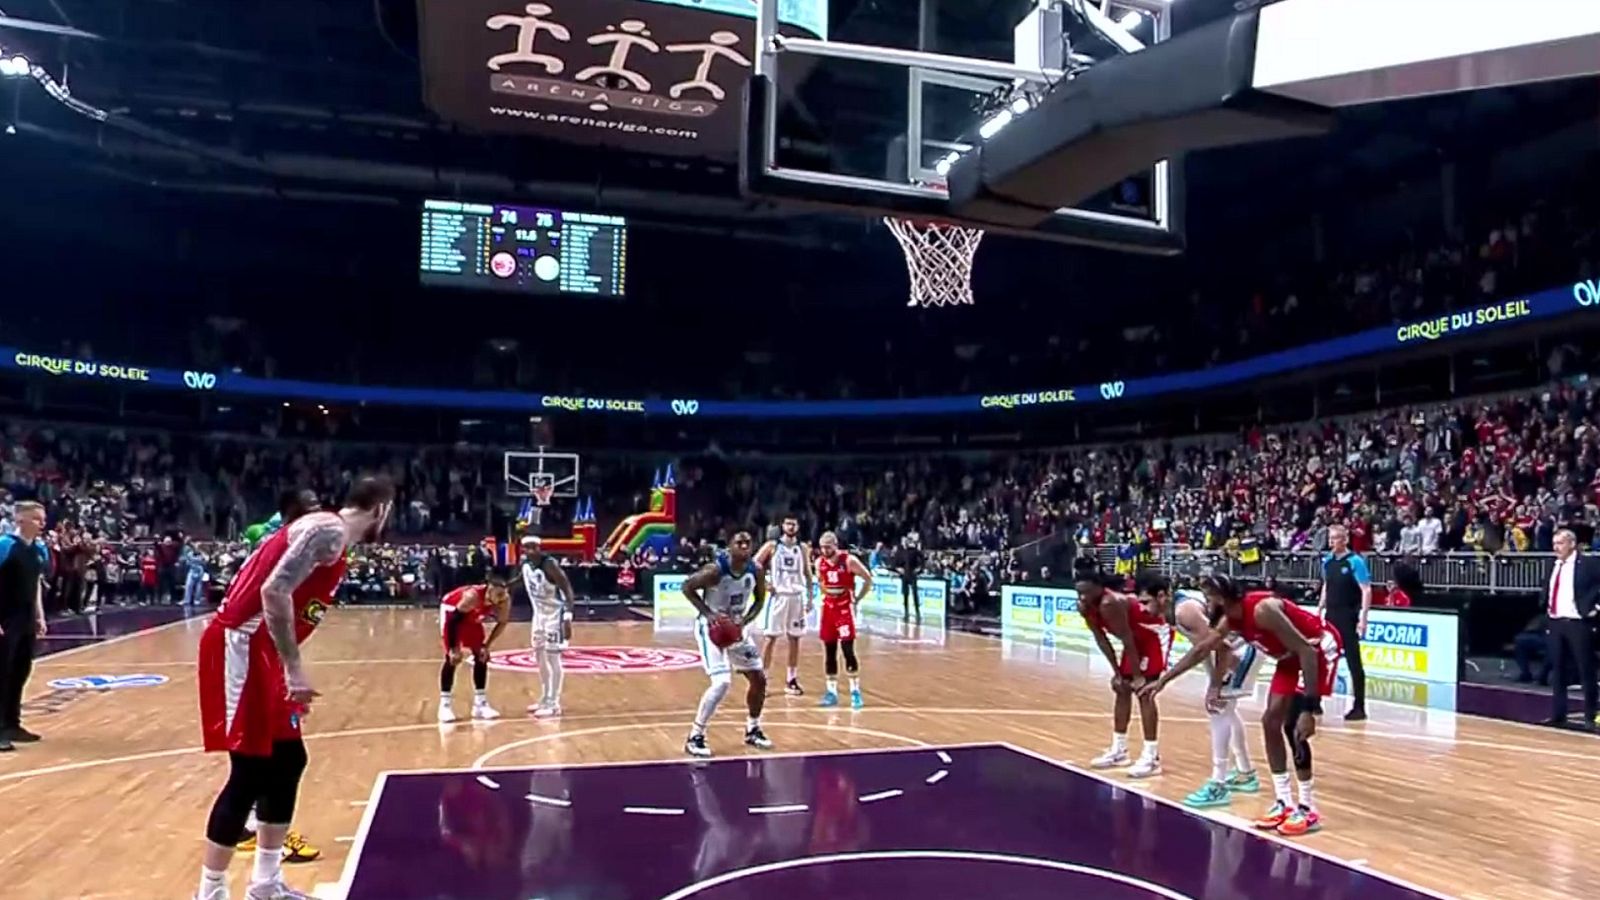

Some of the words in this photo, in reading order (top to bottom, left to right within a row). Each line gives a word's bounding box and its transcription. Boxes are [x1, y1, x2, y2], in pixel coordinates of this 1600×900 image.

[501, 78, 609, 102] ARENA
[631, 97, 706, 114] RIGA
[489, 106, 699, 139] www.arenariga.com
[1573, 279, 1600, 307] OV
[1397, 316, 1449, 341] CIRQUE
[1451, 311, 1473, 330] DU
[1475, 300, 1531, 325] SOLEIL
[15, 352, 72, 375] CIRQUE
[74, 361, 97, 375] DU
[99, 364, 150, 381] SOLEIL
[183, 370, 216, 389] OVO
[541, 395, 585, 411] CIRQUE
[587, 398, 604, 409] DU
[605, 399, 645, 412] SOLEIL
[671, 399, 699, 415] OVO
[981, 394, 1020, 409] CIRQUE
[1021, 393, 1037, 405] DU
[1038, 389, 1076, 403] SOLEIL
[1364, 623, 1422, 646] ЕРОЯМ
